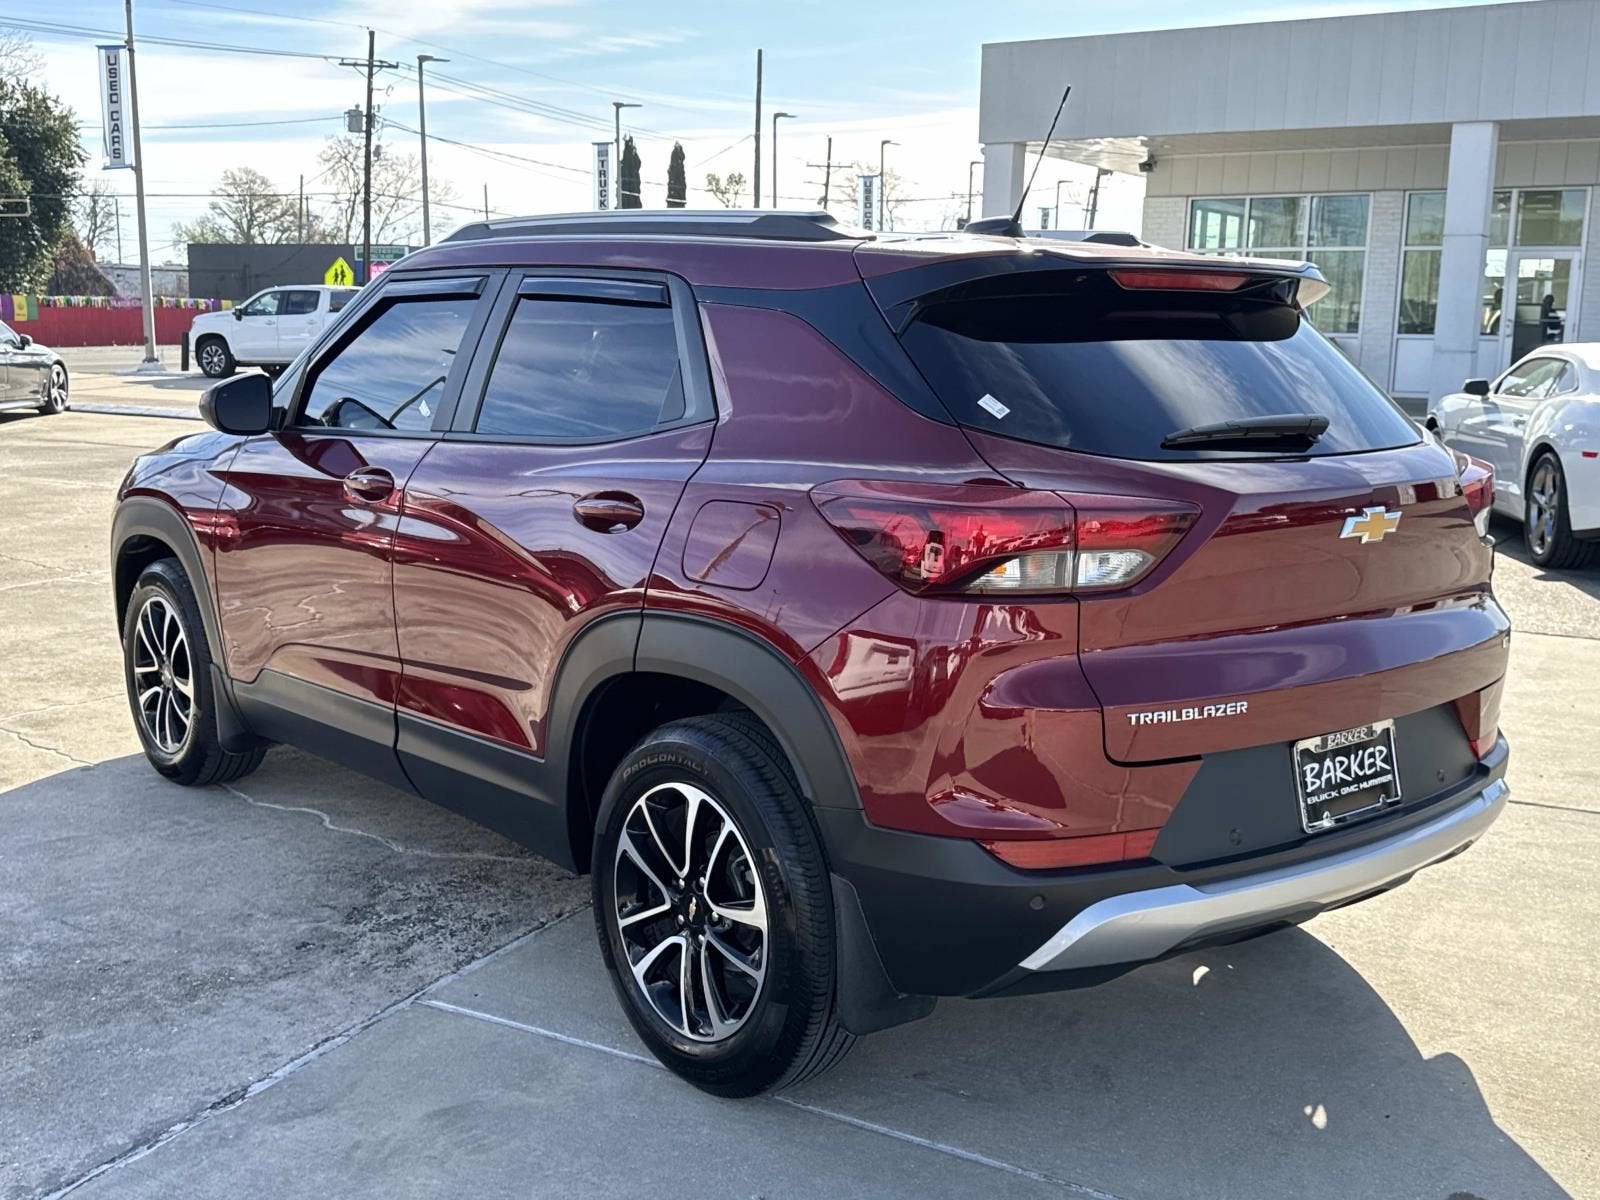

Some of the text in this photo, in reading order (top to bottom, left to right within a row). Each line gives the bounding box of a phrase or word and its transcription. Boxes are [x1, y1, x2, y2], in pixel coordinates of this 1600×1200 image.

[107, 55, 121, 159] USED CARS
[599, 159, 607, 208] TRUCK
[1127, 701, 1248, 726] TRAILBLAZER
[1327, 727, 1368, 747] BARKER
[1303, 745, 1391, 793] BARKER
[1306, 789, 1340, 805] BUICK
[1340, 784, 1360, 796] GMC
